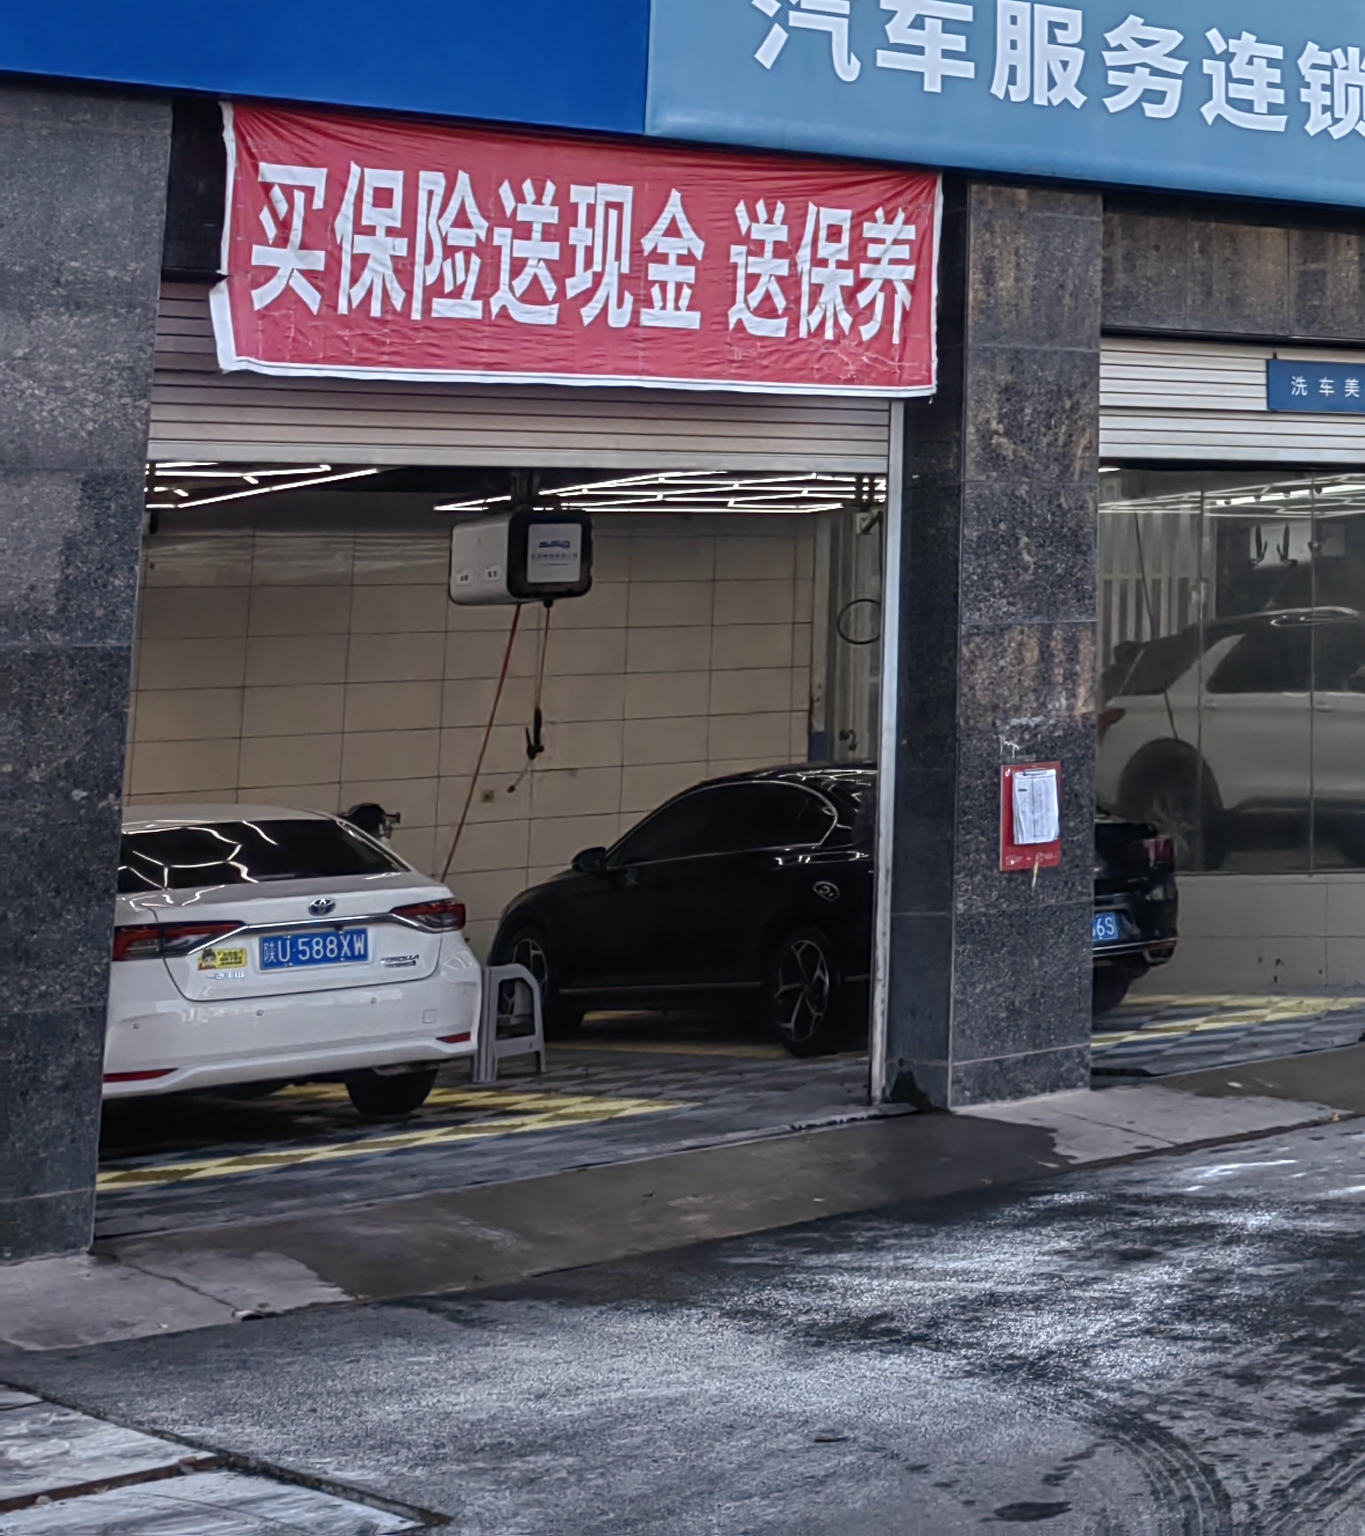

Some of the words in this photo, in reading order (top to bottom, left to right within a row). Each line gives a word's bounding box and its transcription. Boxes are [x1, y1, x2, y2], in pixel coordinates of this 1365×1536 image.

[250, 161, 702, 331] 买保险送现金
[727, 198, 917, 345] 送保养
[1092, 916, 1115, 937] 6S
[263, 933, 368, 964] 陕U·588XW
